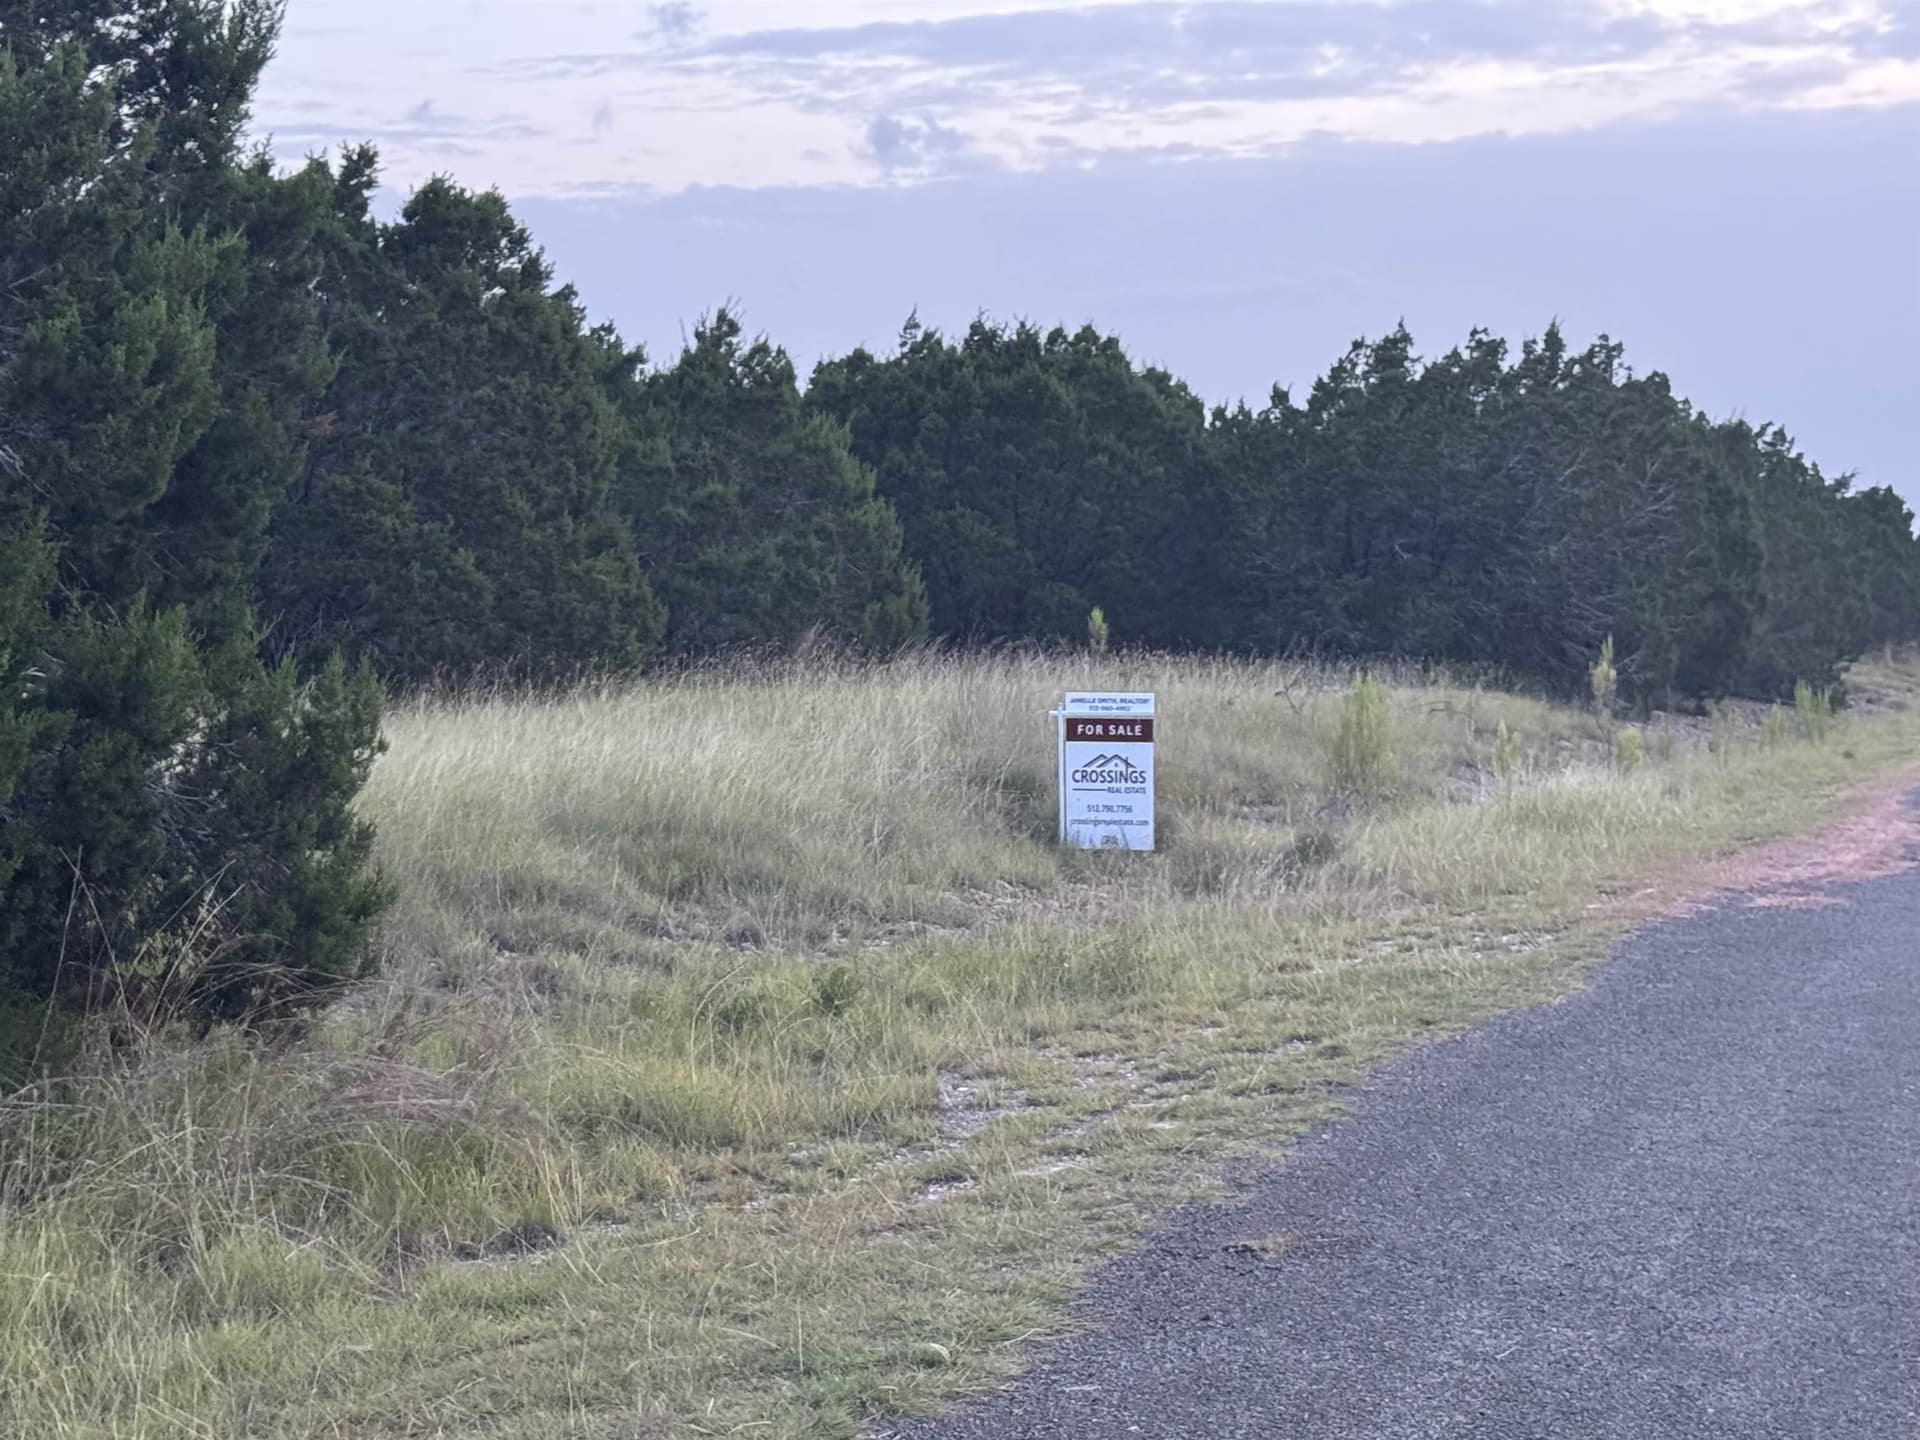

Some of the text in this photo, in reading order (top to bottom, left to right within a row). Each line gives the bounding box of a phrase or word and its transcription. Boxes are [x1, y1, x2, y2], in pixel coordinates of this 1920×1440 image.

[1076, 724, 1143, 736] FOR SALE
[1071, 769, 1147, 784] CROSSINGS
[1106, 786, 1147, 795] REAL ESTATE
